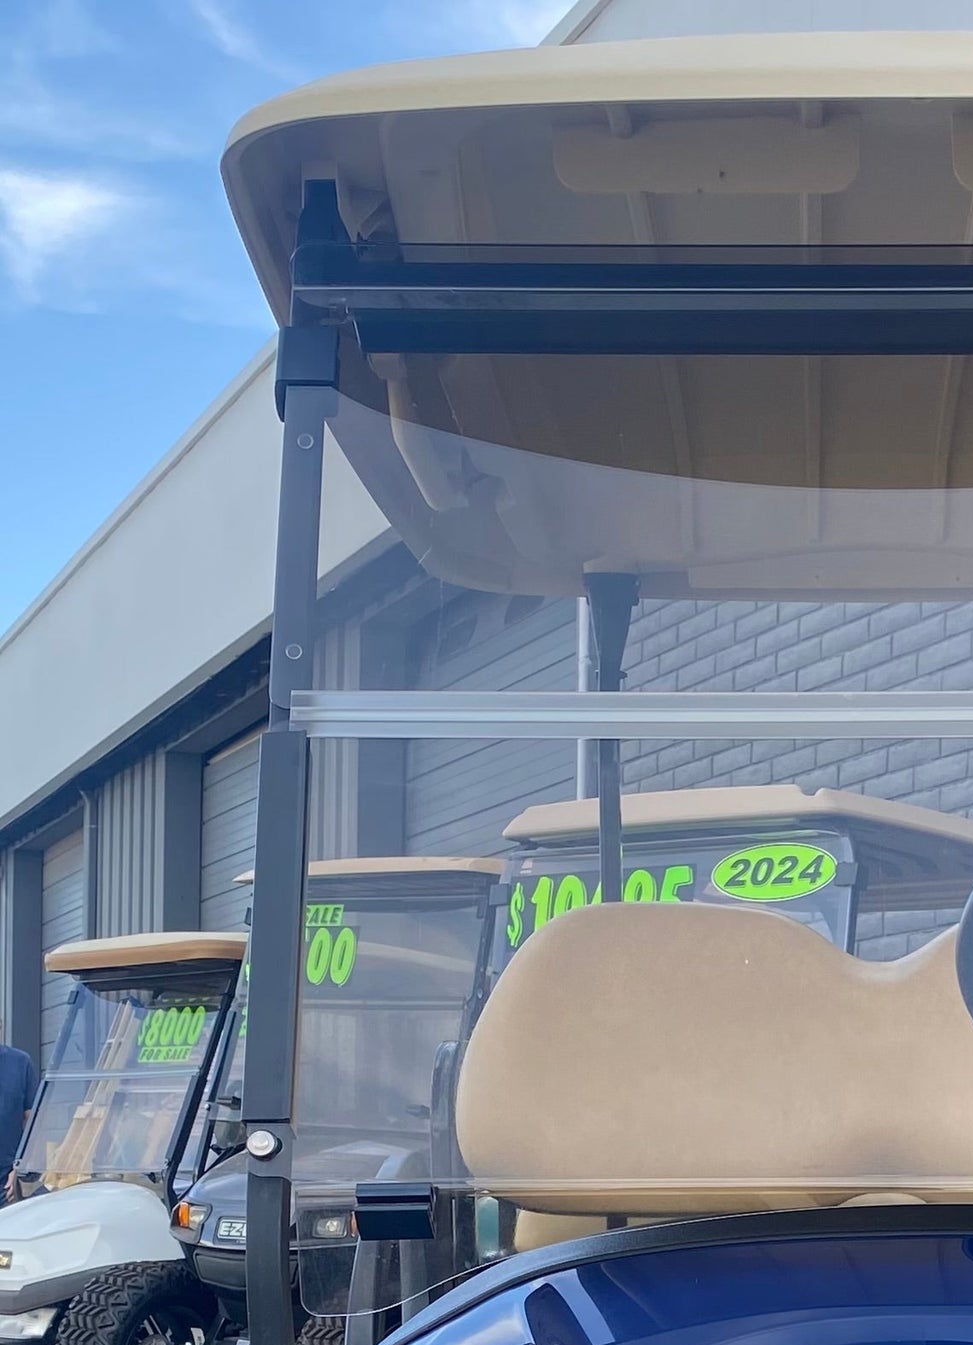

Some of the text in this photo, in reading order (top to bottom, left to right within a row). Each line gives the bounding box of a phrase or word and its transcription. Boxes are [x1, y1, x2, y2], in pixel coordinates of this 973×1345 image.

[724, 854, 825, 888] 2024
[305, 926, 357, 986] 00
[138, 1006, 206, 1047] $8000
[140, 1048, 191, 1060] FOR SALE
[219, 1222, 247, 1237] EZ
